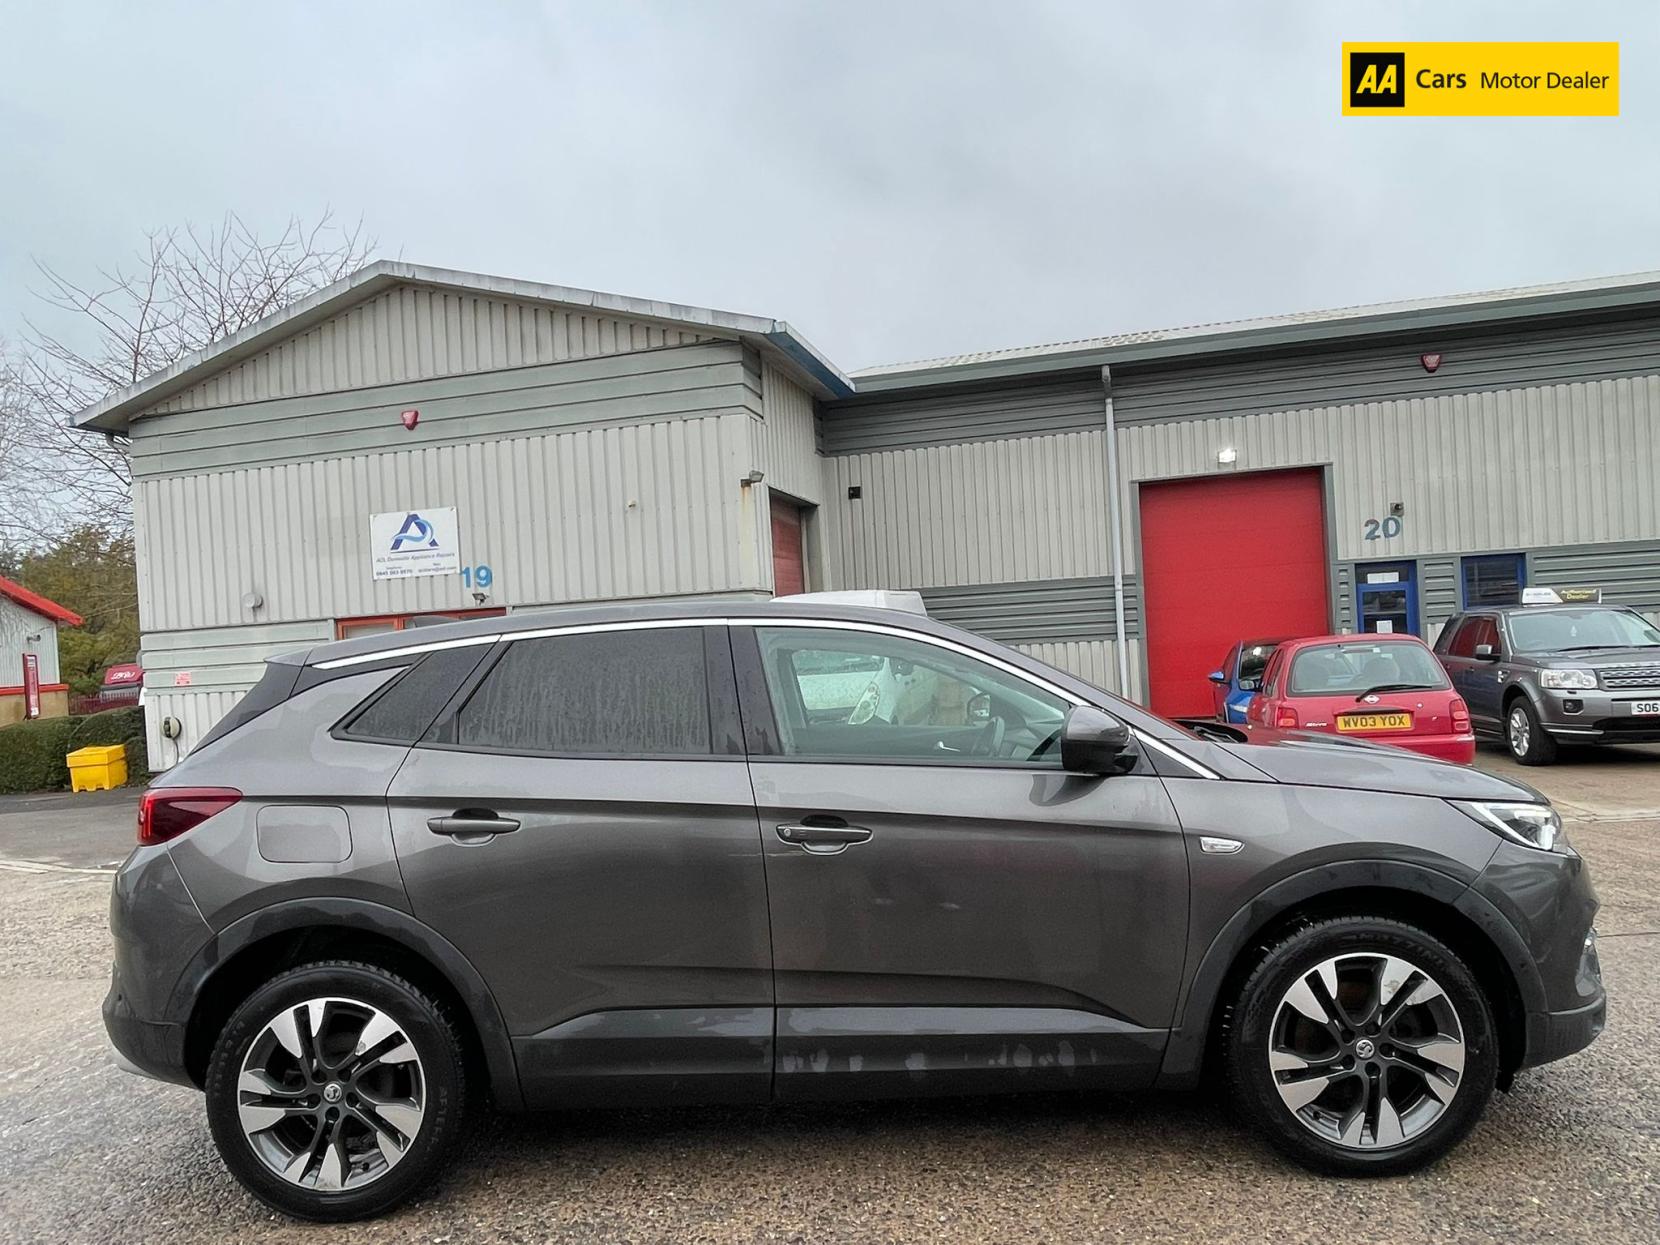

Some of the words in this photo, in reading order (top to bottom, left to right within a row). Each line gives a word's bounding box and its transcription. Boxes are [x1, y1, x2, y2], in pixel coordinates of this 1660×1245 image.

[1364, 516, 1401, 540] 20
[462, 565, 493, 588] 19
[1343, 716, 1377, 728] WV03
[1381, 715, 1405, 727] YOX
